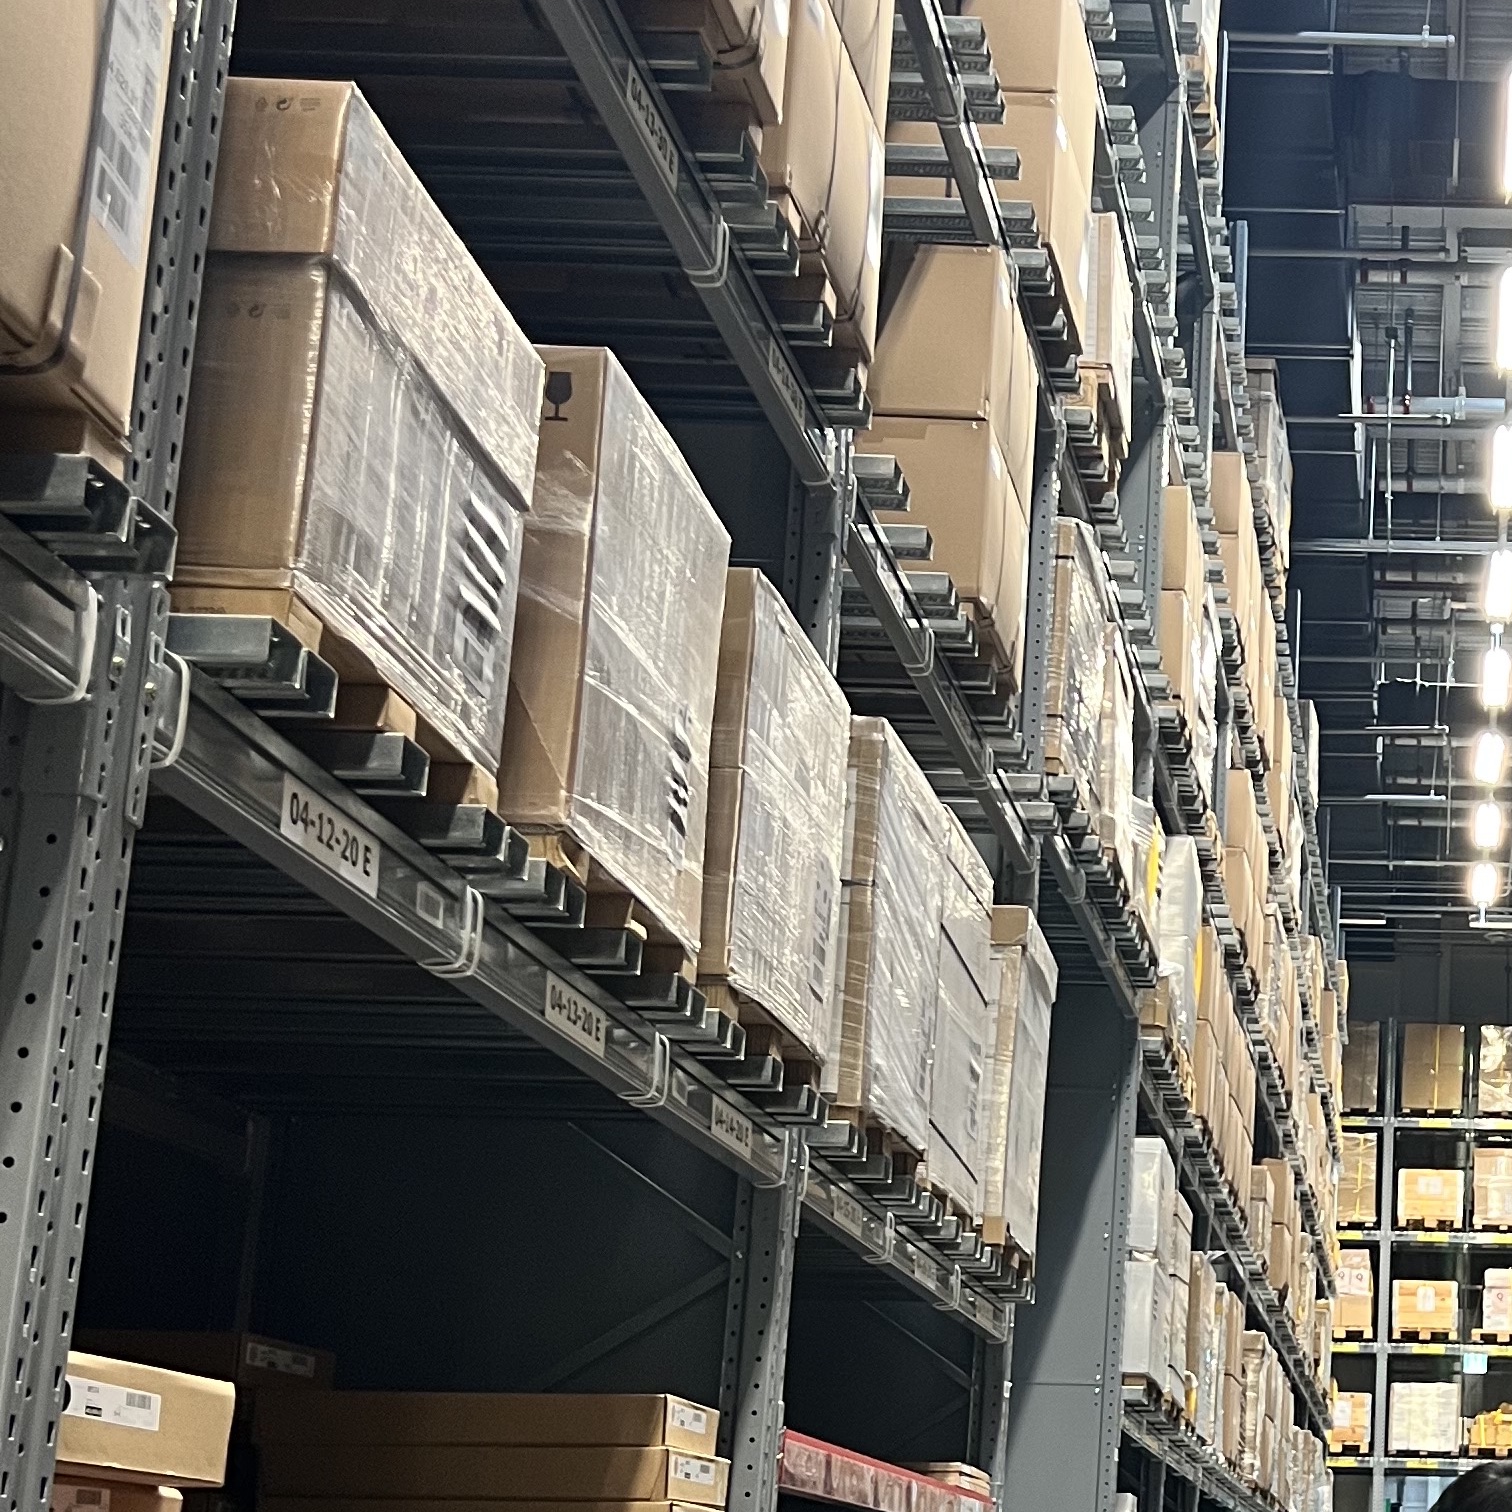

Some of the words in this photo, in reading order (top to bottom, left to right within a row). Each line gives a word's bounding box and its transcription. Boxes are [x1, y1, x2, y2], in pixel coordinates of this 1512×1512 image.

[669, 149, 675, 175] E
[289, 791, 359, 868] 04-12-20
[362, 843, 372, 878] E
[550, 984, 594, 1037] 04-13-20
[595, 1016, 602, 1042] E
[744, 1126, 749, 1148] E
